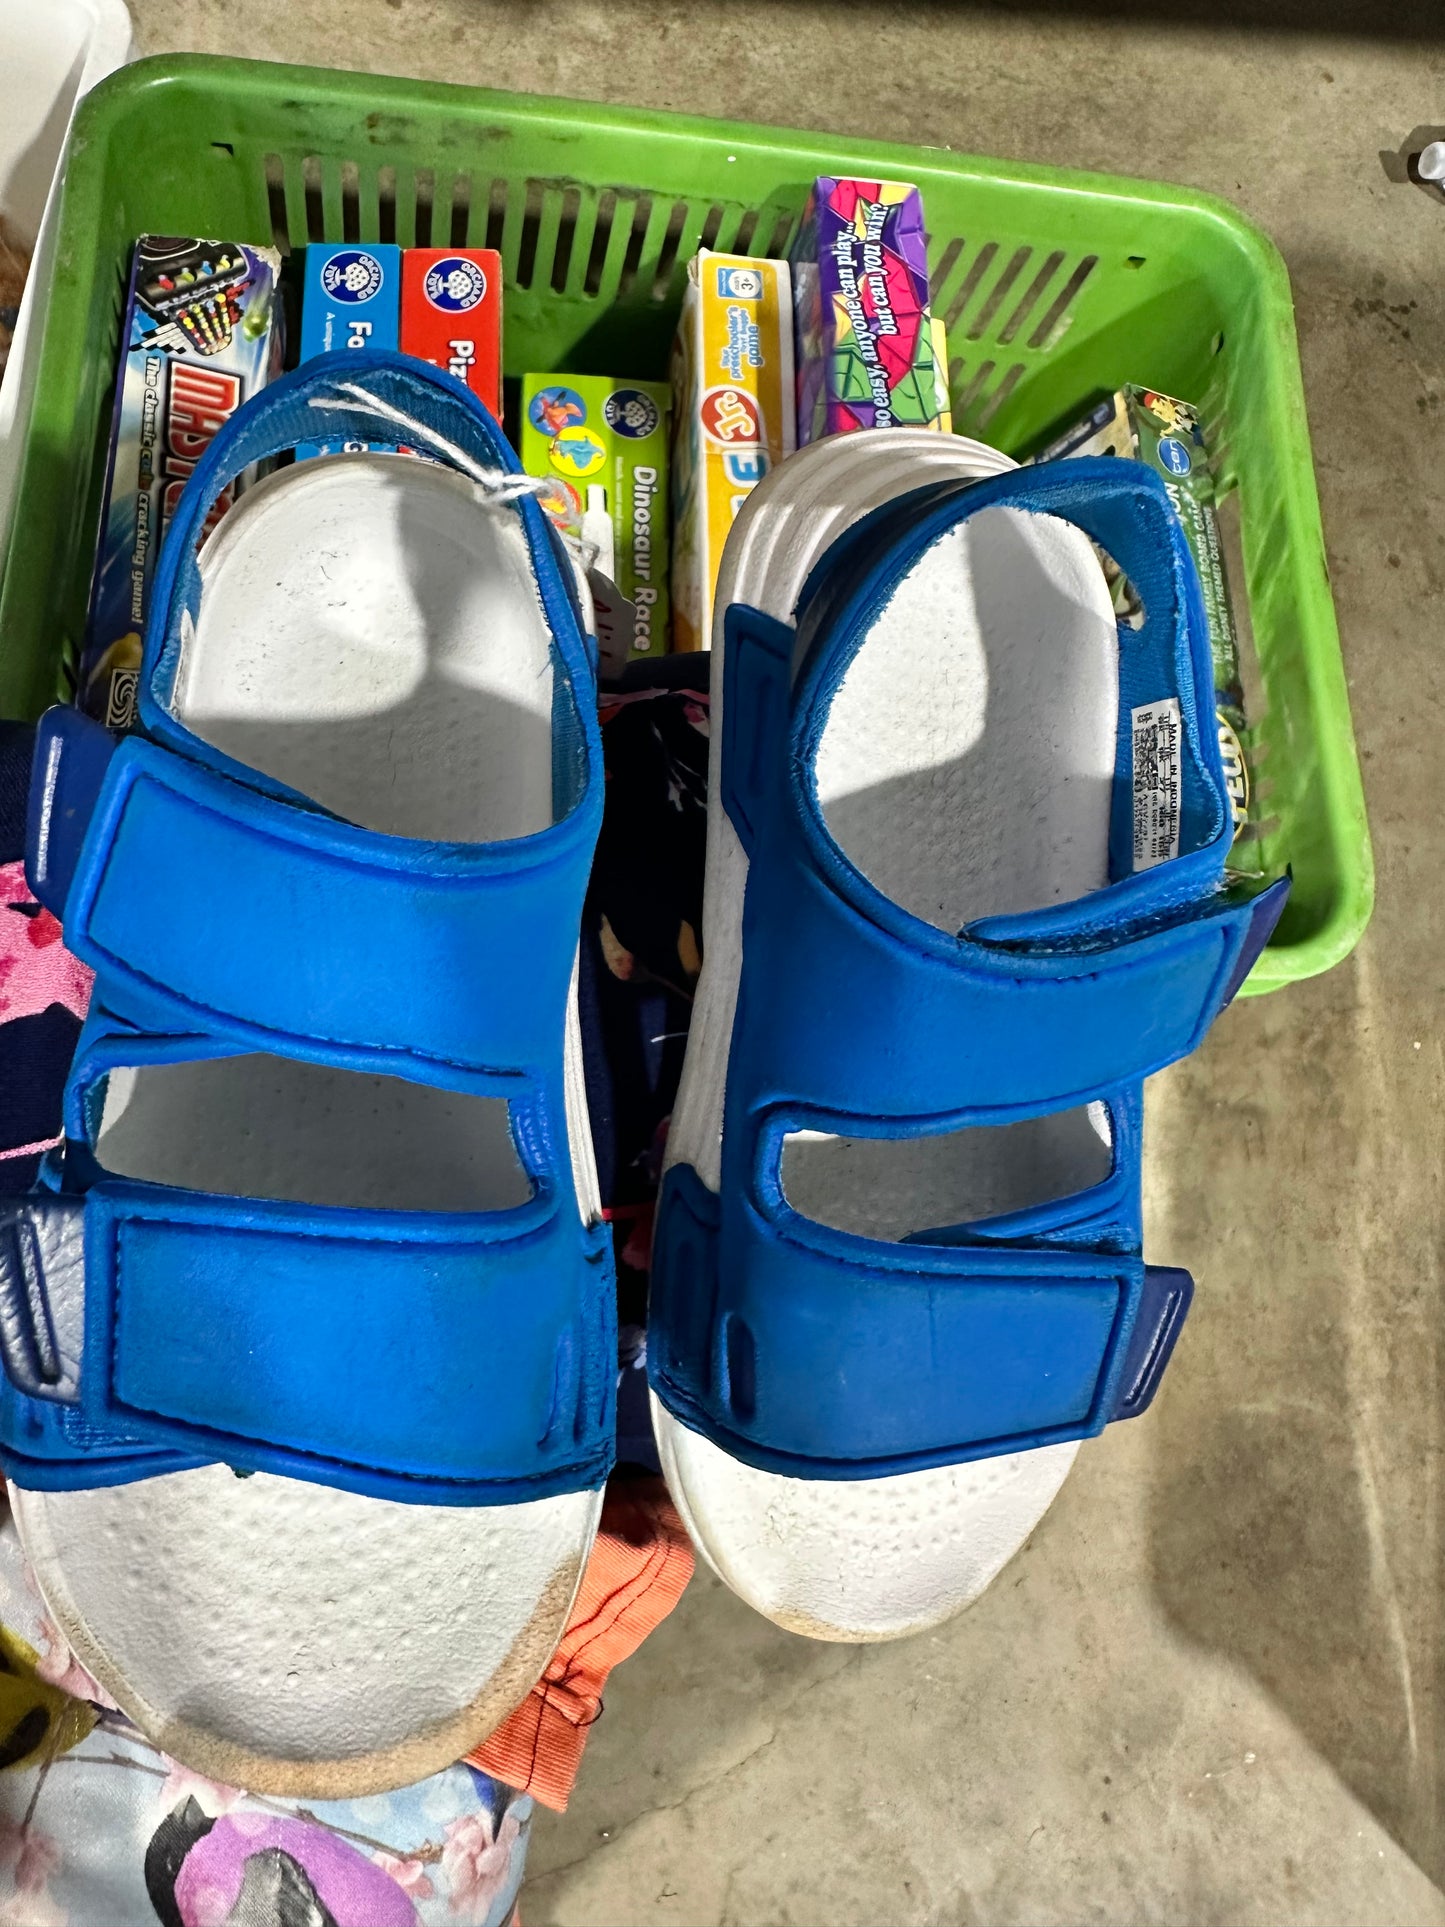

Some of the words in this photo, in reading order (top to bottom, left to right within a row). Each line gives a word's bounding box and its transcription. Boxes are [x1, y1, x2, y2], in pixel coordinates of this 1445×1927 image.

[832, 220, 856, 267] play...
[864, 202, 889, 243] win?
[325, 264, 339, 292] TOYS
[356, 255, 380, 300] ORCHARD
[863, 244, 884, 276] you
[428, 272, 443, 300] TOYS
[460, 262, 484, 308] ORCHARD
[840, 267, 859, 299] can
[867, 276, 889, 306] can
[847, 300, 879, 362] anyone
[875, 307, 898, 336] but
[448, 340, 476, 385] Piz
[748, 325, 763, 366] game
[146, 356, 162, 387] The
[866, 363, 891, 407] easy,
[141, 388, 158, 446] classic
[138, 448, 154, 491] code
[132, 492, 151, 565] cracking
[632, 465, 659, 580] Dinosaur
[1196, 534, 1211, 573] BOARD
[130, 570, 145, 625] game!
[633, 586, 658, 651] Race
